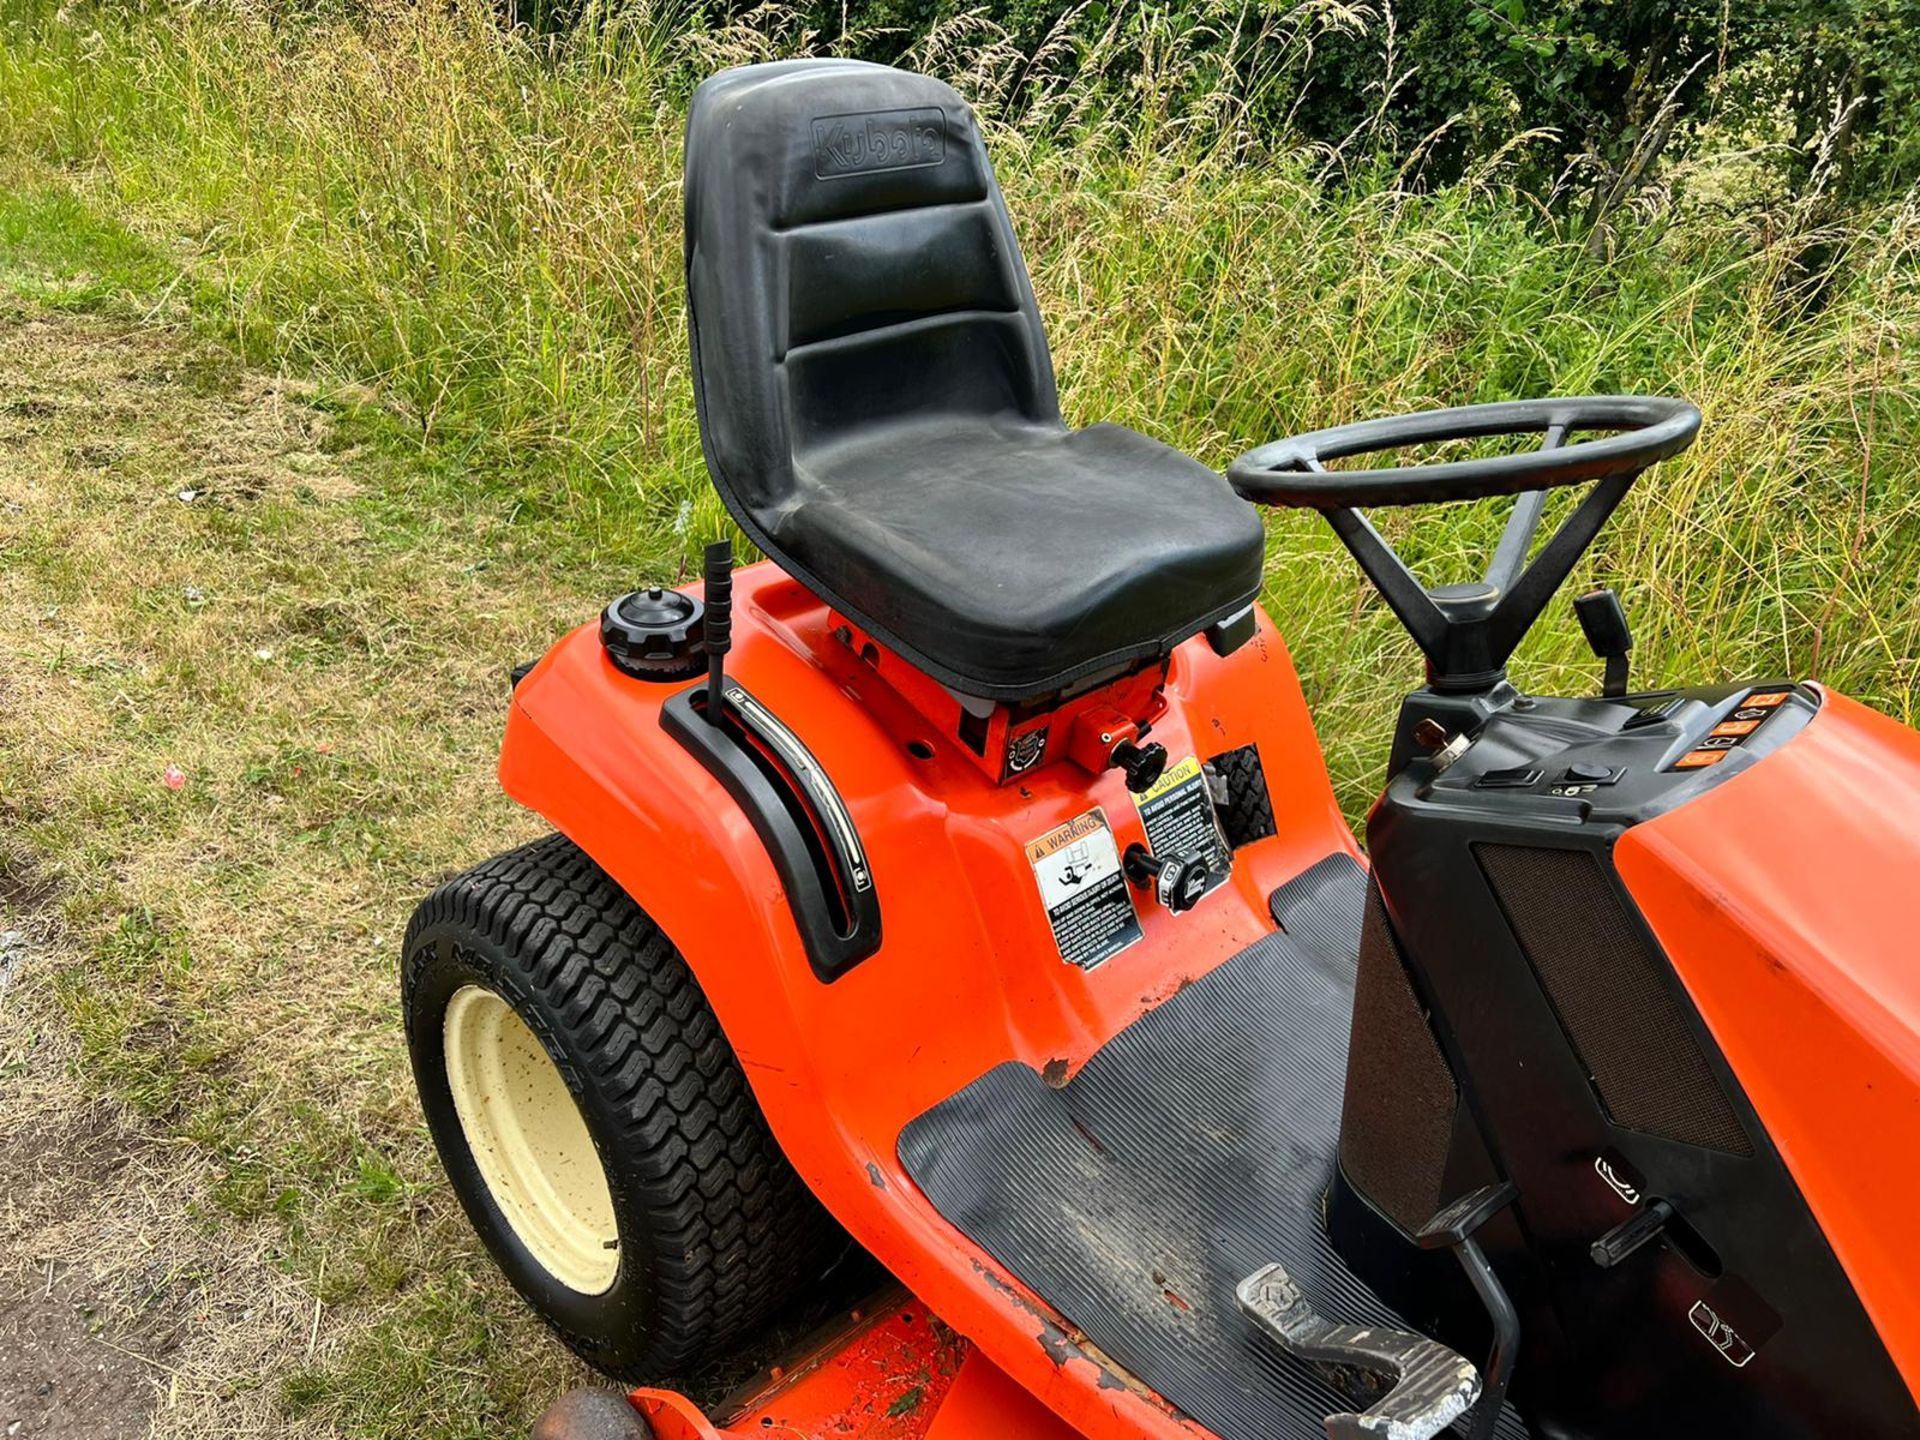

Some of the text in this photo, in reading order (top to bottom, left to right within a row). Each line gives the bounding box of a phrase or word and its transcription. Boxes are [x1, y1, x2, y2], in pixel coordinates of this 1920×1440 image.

[815, 116, 941, 167] Kubota
[1151, 764, 1191, 793] CAUTION
[1046, 817, 1097, 850] WARNING
